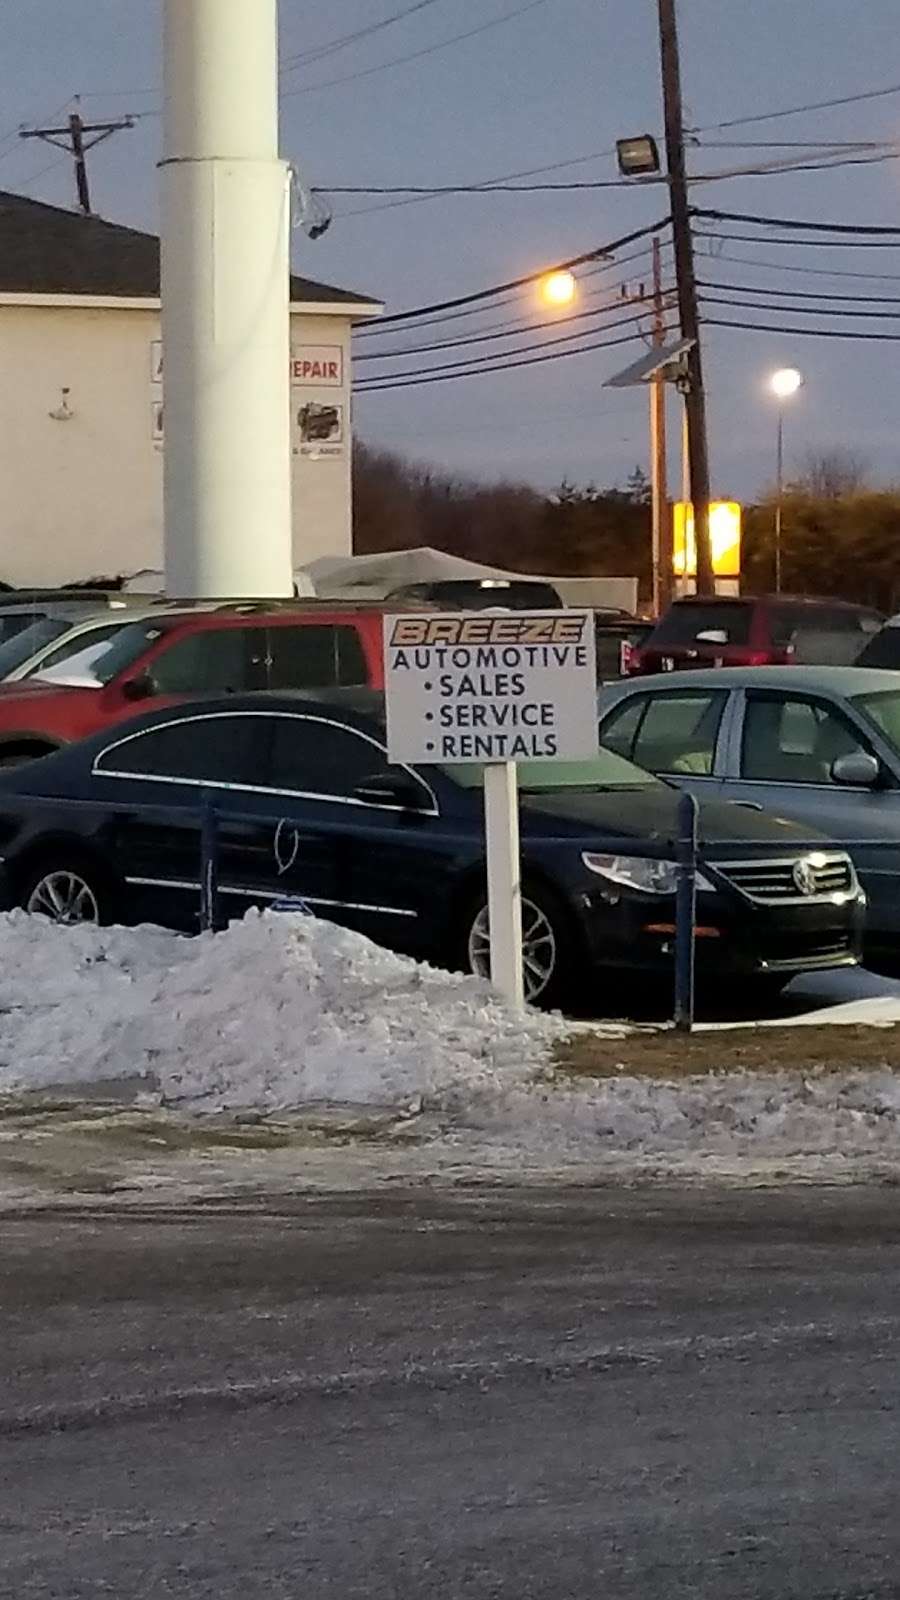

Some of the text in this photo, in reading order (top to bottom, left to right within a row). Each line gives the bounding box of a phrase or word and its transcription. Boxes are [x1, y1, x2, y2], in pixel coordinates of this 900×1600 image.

[290, 360, 338, 378] EPAIR
[390, 615, 587, 646] BREEZE
[393, 646, 587, 669] AUTOMOTIVE
[439, 674, 526, 697] SALES
[439, 704, 555, 727] SERVICE
[442, 734, 558, 758] RENTALS
